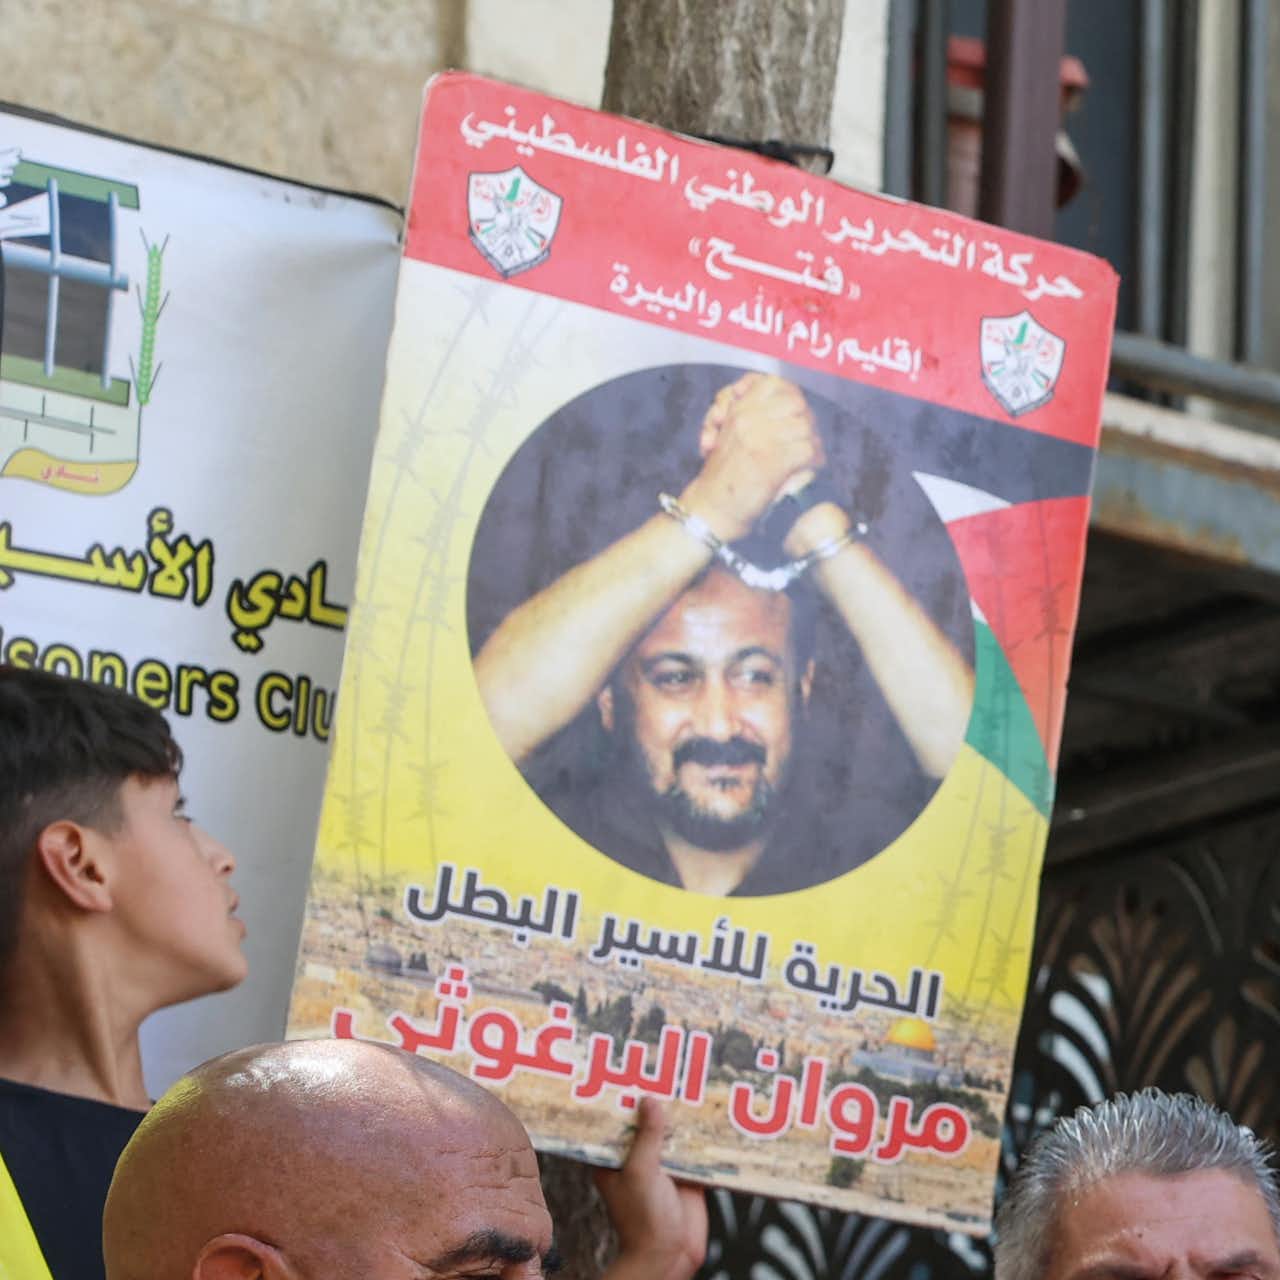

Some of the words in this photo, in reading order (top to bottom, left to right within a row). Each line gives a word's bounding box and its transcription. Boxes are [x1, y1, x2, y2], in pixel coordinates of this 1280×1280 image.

[460, 105, 680, 184] الفلسطيني
[684, 168, 825, 227] الوطني
[822, 217, 976, 269] التحرير
[981, 240, 1083, 301] حركة
[609, 261, 723, 327] والبيرة
[728, 284, 784, 335] الله
[787, 318, 833, 358] رام
[837, 336, 922, 381] إقليم
[226, 558, 348, 655] ادي
[0, 626, 240, 722] soners
[256, 671, 337, 743] Clu
[407, 865, 578, 942] البطل
[592, 916, 769, 980] للأسير
[784, 943, 942, 1018] الحرية
[730, 1050, 970, 1162] مروان
